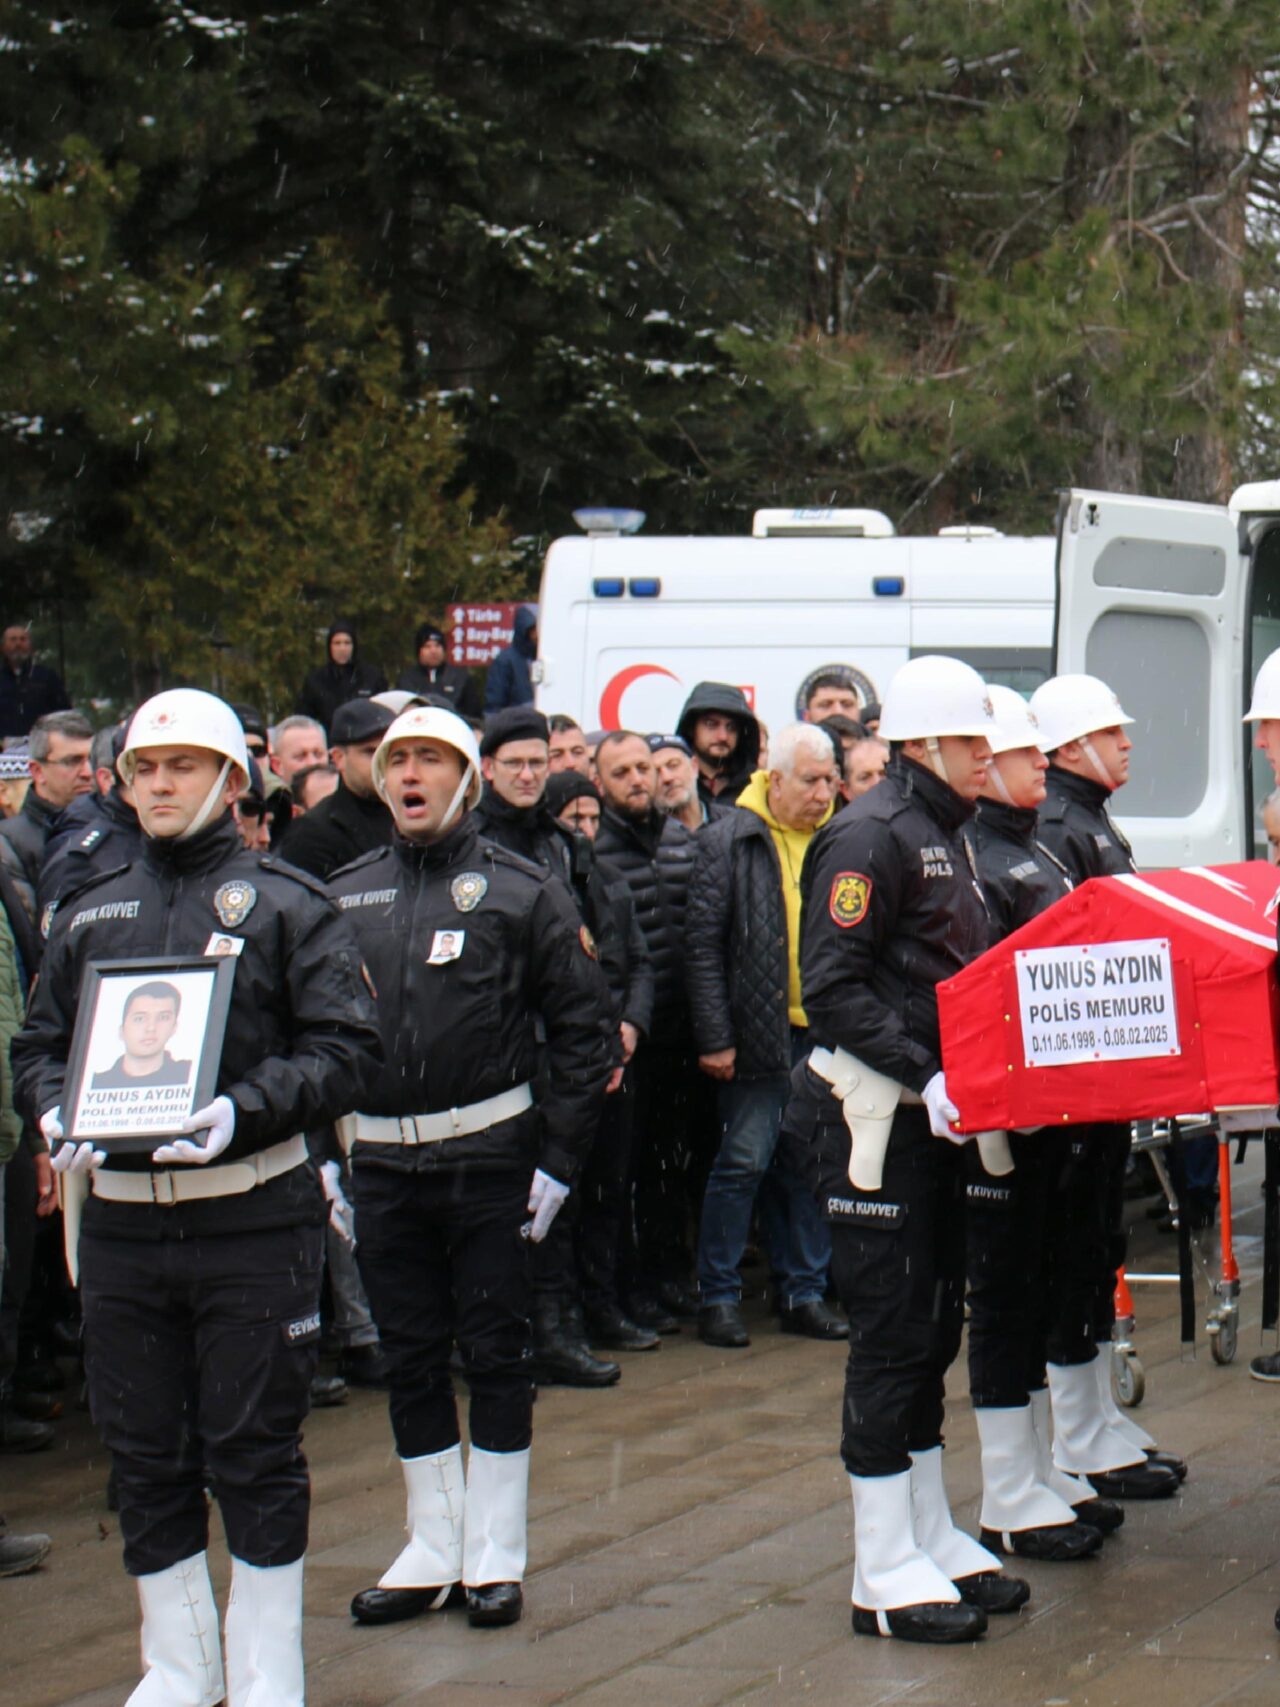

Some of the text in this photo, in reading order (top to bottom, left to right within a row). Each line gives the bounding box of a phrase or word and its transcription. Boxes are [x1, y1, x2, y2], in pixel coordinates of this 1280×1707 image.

[466, 628, 514, 644] Bay-Bay
[98, 900, 140, 919] KUVVET
[1026, 953, 1163, 992] YUNUS AYDIN
[1030, 994, 1165, 1024] POLİS MEMURU
[1032, 1030, 1095, 1053] D.11.06.1998
[1103, 1025, 1168, 1047] Ö.08.02.2025
[86, 1087, 192, 1104] YUNUS AYDIN
[81, 1103, 188, 1117] POLİS MEMURU
[856, 1201, 900, 1218] KUVVET
